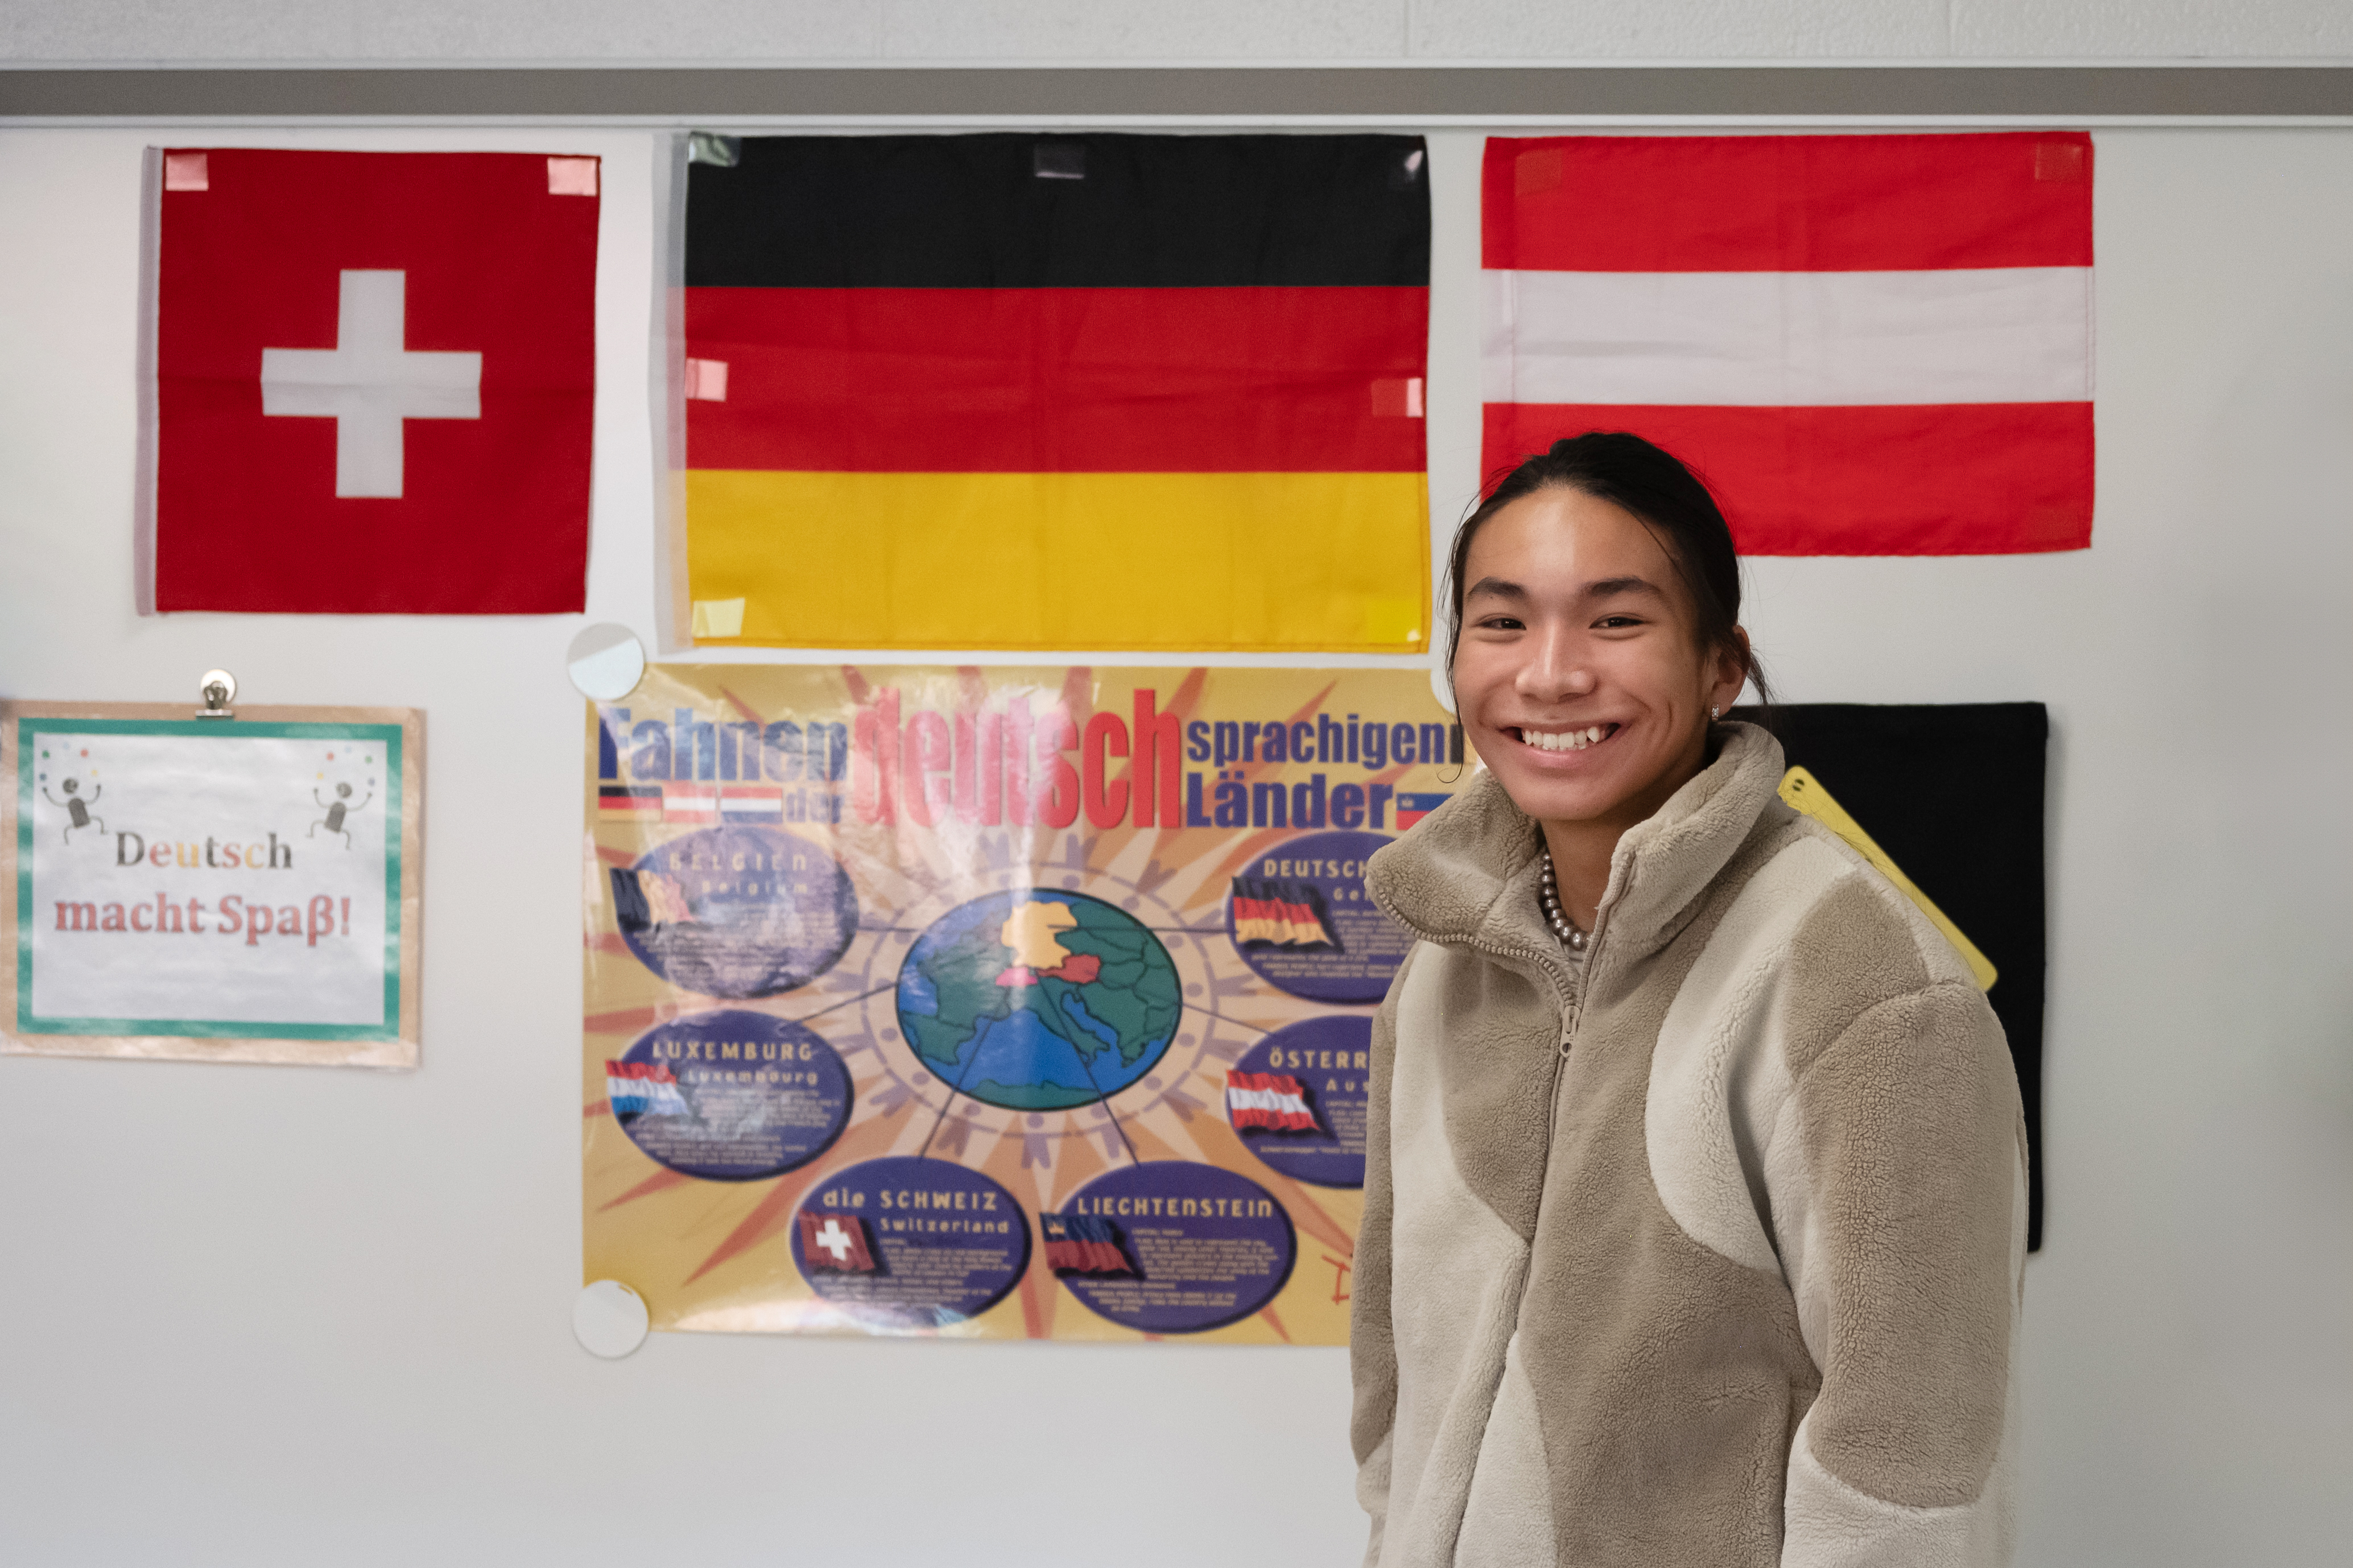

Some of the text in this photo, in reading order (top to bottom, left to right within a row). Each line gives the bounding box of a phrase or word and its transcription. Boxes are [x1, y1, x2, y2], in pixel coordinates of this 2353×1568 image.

[598, 687, 1446, 829] Fahnen deutsch sprachigen
[1187, 771, 1393, 830] Länder
[117, 831, 292, 869] Deutsch
[55, 892, 205, 934] macht
[653, 1041, 813, 1061] LUXEMBURG
[880, 1190, 997, 1211] SCHWEIZ
